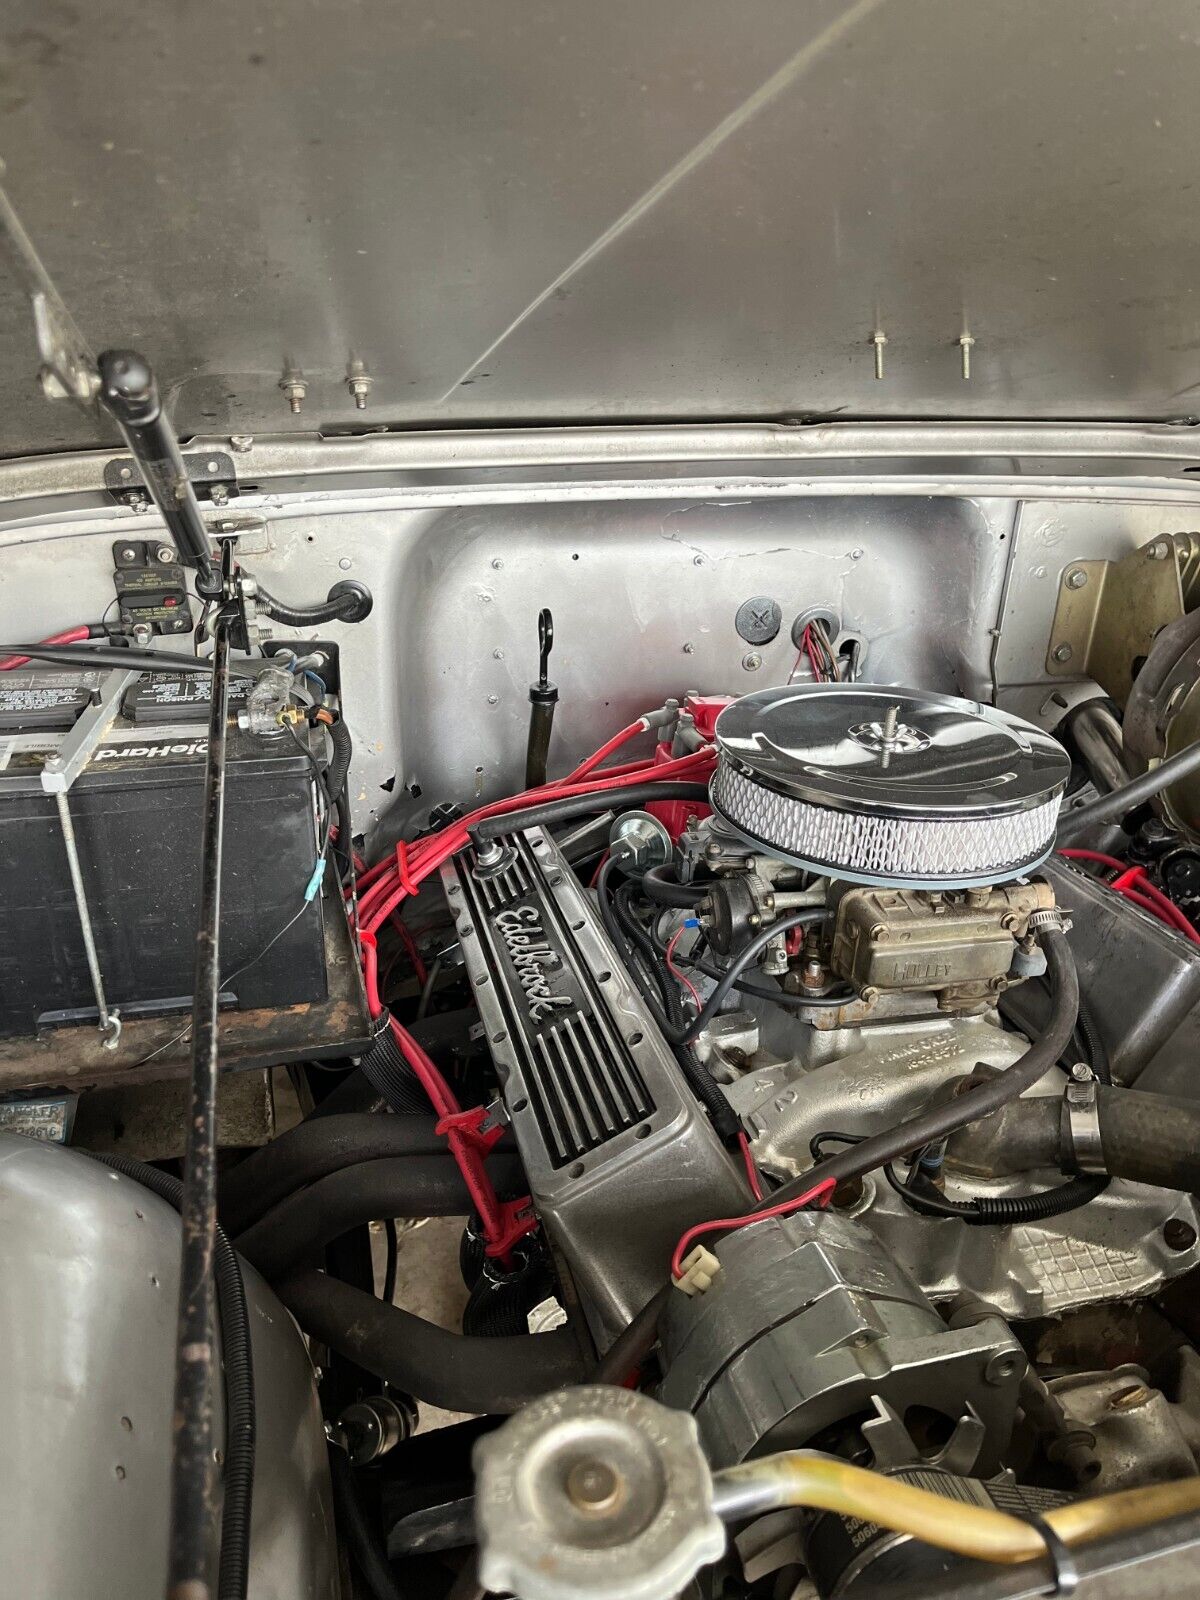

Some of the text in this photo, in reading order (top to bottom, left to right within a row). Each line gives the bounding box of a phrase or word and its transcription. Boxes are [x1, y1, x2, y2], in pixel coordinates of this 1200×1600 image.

[93, 742, 210, 762] DieHard
[495, 905, 573, 1025] Edelbrock
[892, 962, 952, 981] HOLLEY
[851, 1521, 881, 1548] 5060
